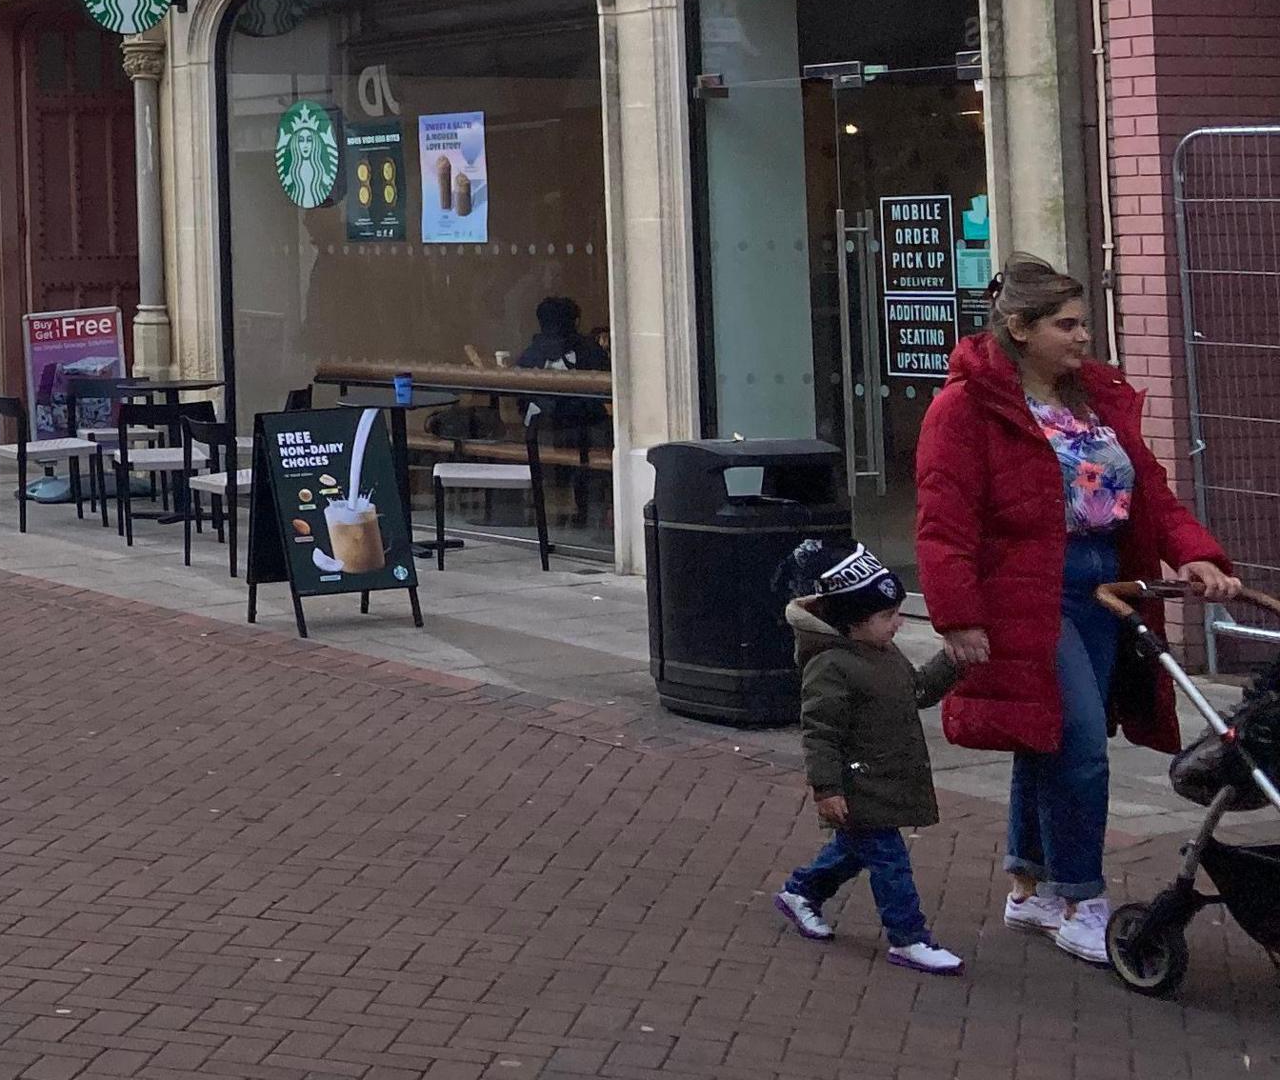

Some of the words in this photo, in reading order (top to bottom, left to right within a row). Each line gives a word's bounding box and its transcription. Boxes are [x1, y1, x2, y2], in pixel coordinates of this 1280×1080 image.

[891, 203, 943, 221] MOBILE
[895, 227, 941, 245] ORDER
[892, 252, 925, 270] PICK
[927, 251, 946, 269] UP
[900, 276, 946, 288] DELIVERY
[889, 304, 954, 322] ADDITIONAL
[32, 320, 53, 331] Buy
[34, 330, 54, 341] Get
[61, 316, 113, 338] Free
[899, 328, 946, 347] SEATING
[896, 351, 950, 370] UPSTAIRS
[276, 431, 312, 446] FREE
[279, 442, 344, 457] NON-DAIRY
[281, 455, 329, 469] CHOICES
